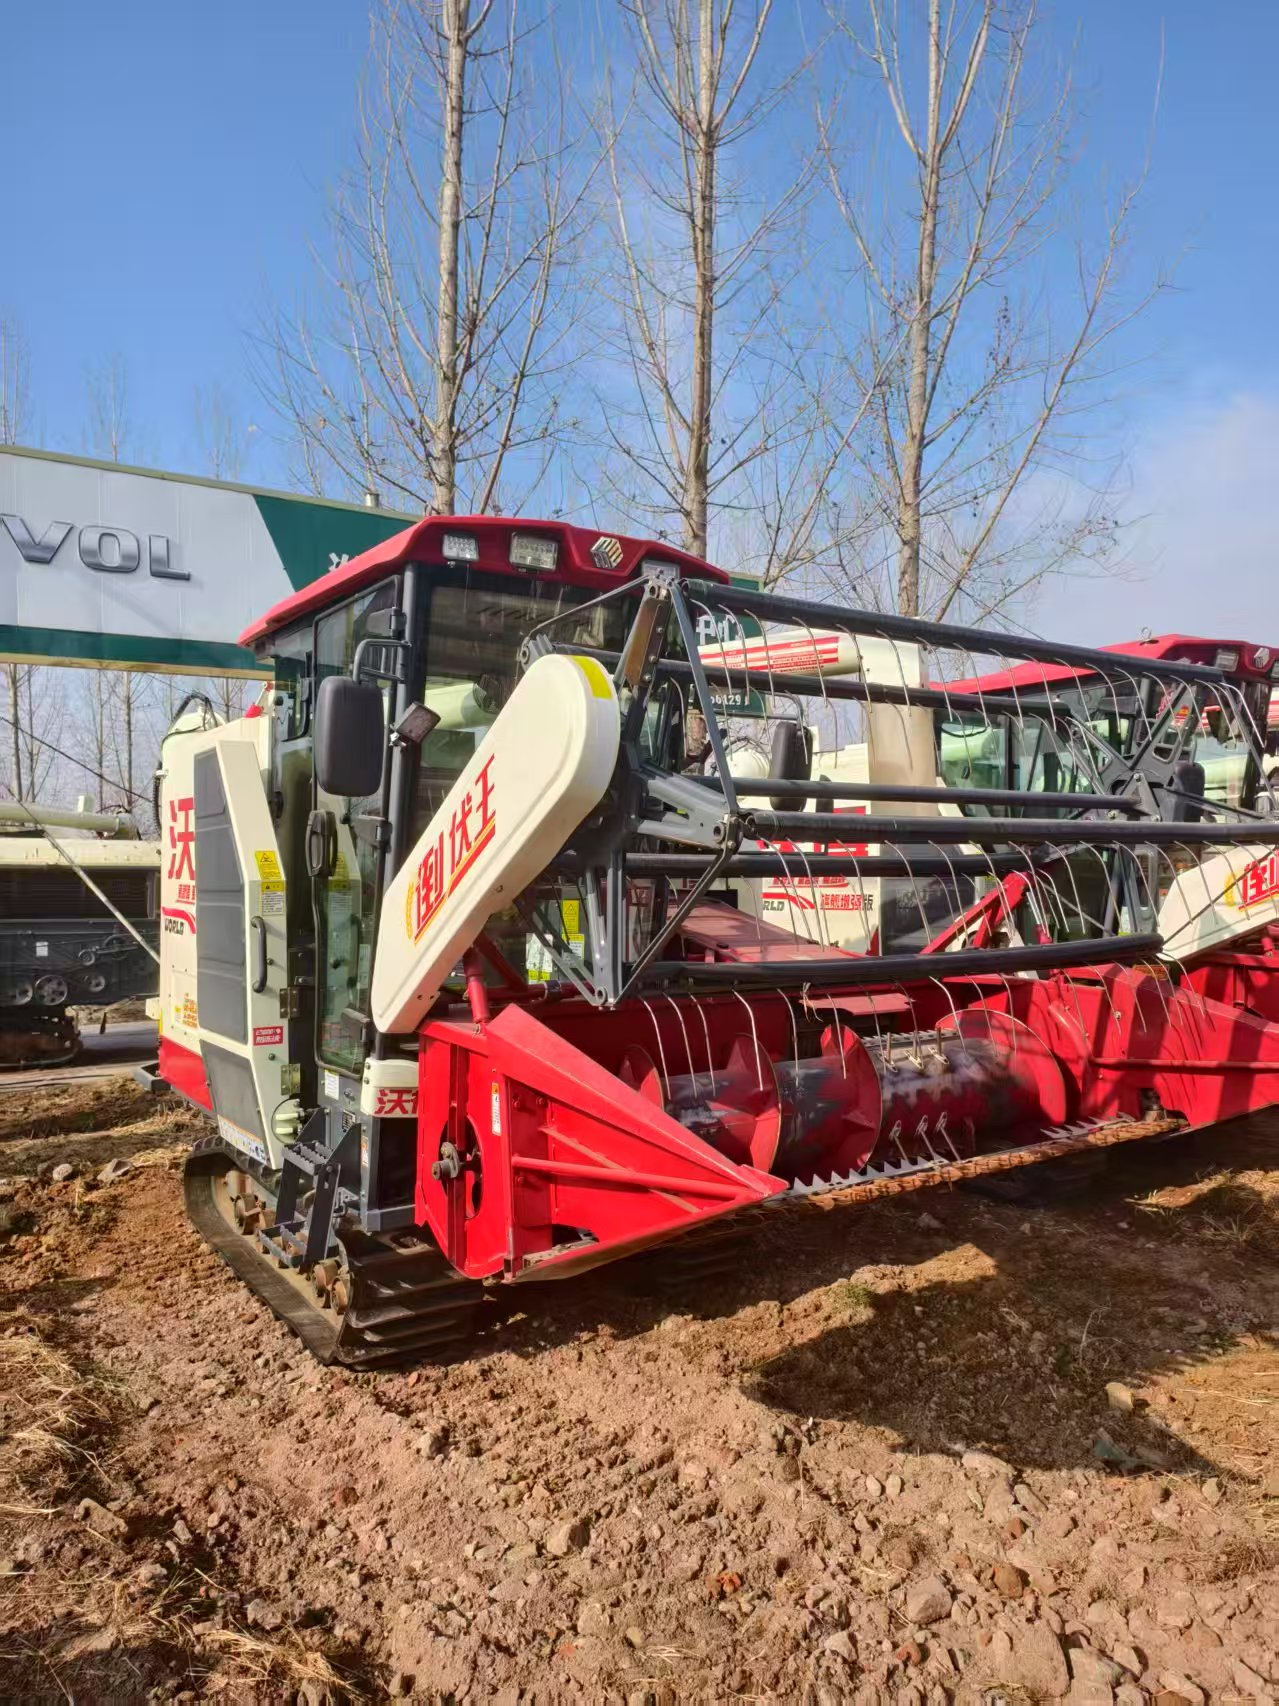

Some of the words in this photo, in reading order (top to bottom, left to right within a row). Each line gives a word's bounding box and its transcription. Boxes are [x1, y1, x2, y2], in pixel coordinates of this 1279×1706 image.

[0, 513, 191, 581] VOL
[416, 753, 496, 930] 倒伏王
